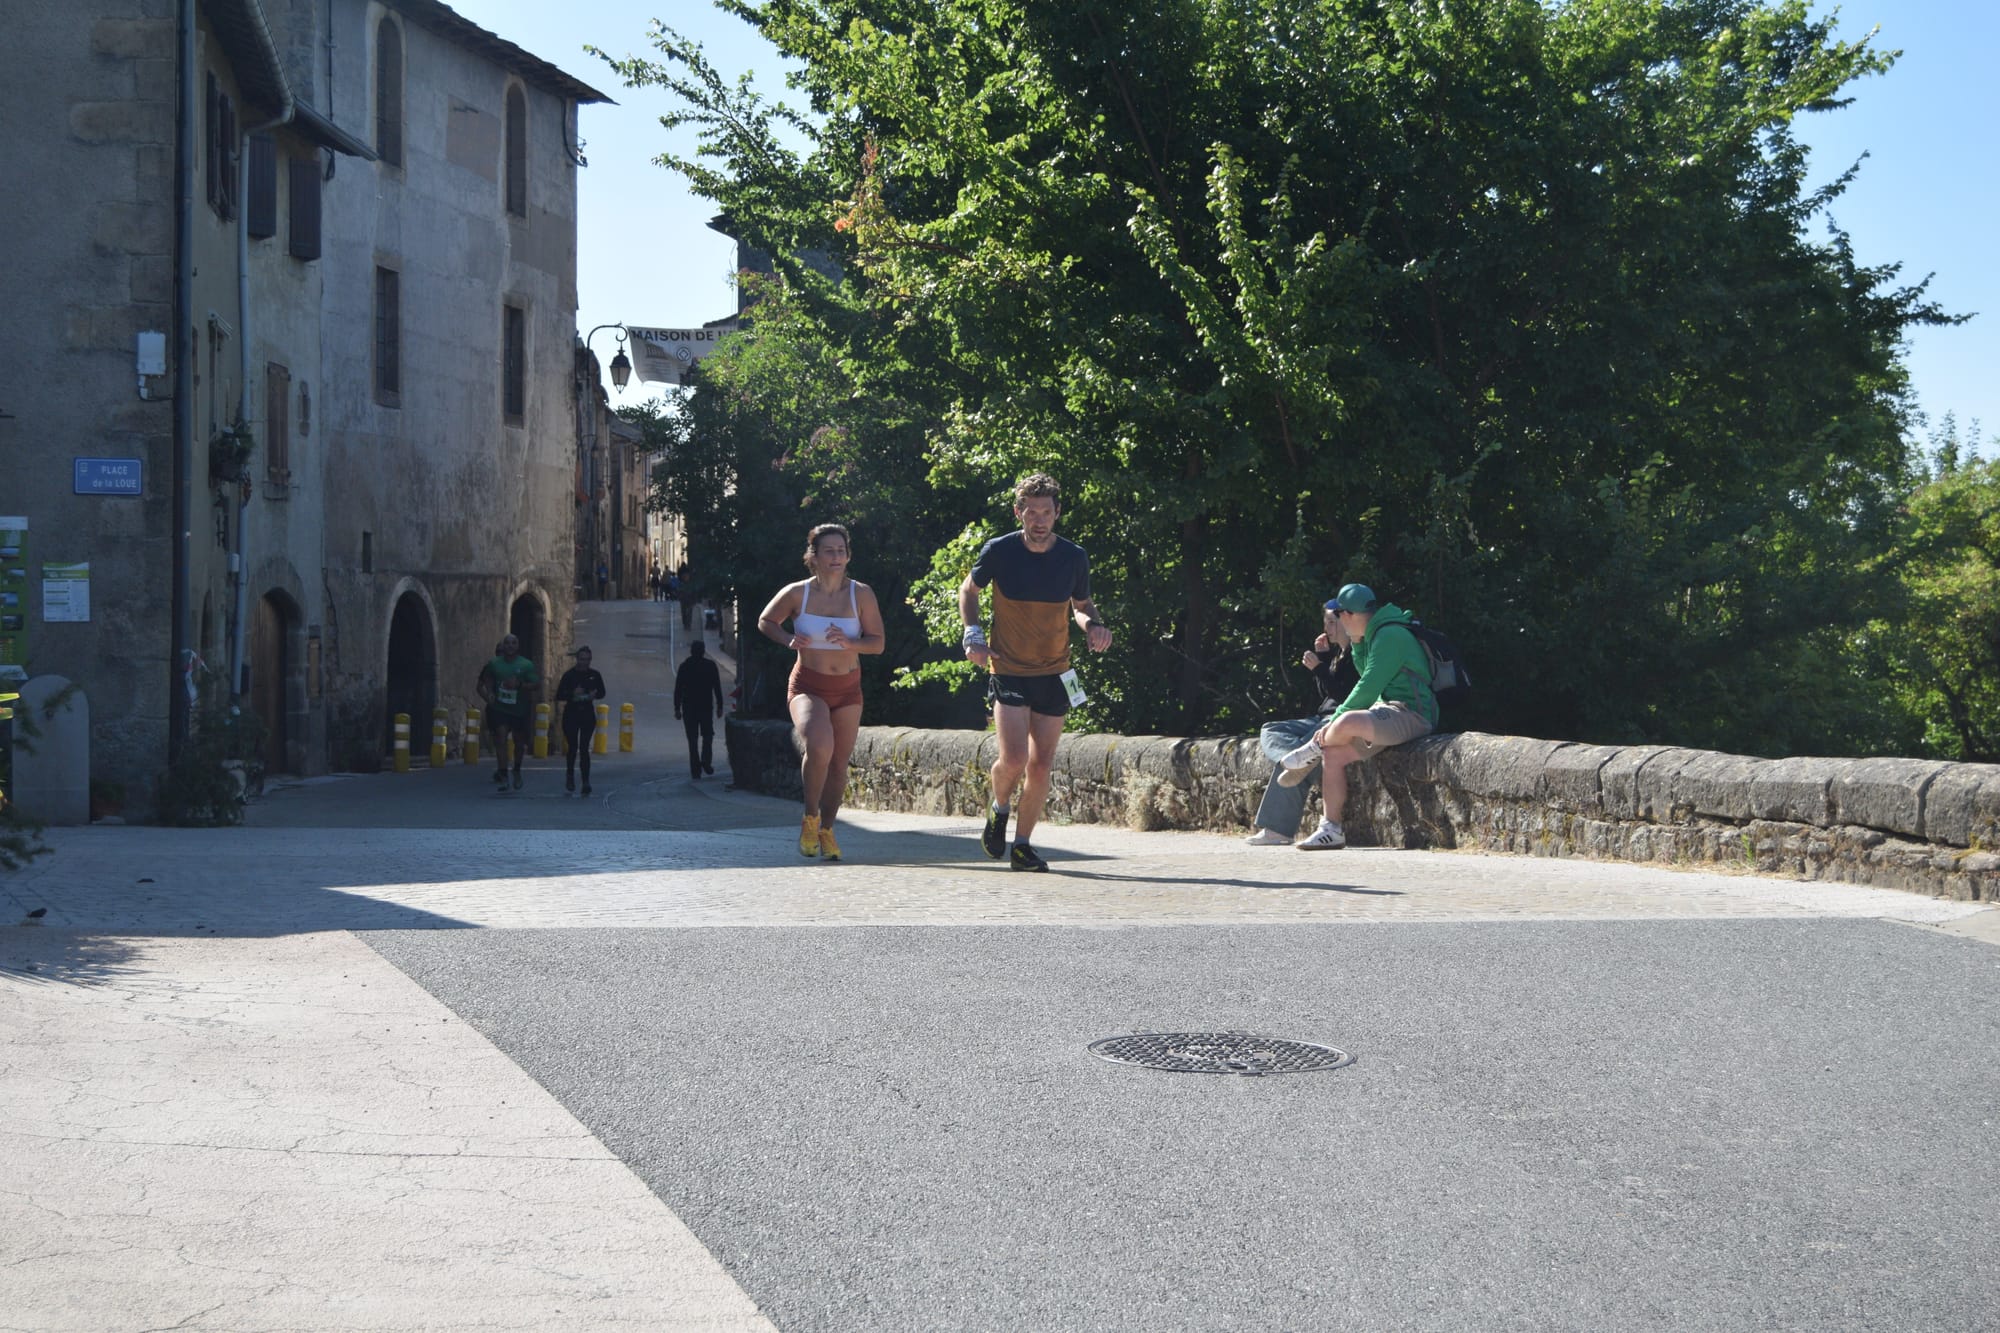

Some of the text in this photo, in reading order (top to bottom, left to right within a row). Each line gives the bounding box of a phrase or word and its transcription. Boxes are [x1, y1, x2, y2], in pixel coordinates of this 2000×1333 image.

[630, 330, 690, 341] MAISON
[695, 331, 714, 341] DE
[101, 465, 128, 475] PLACE
[92, 478, 137, 488] de la LOUE
